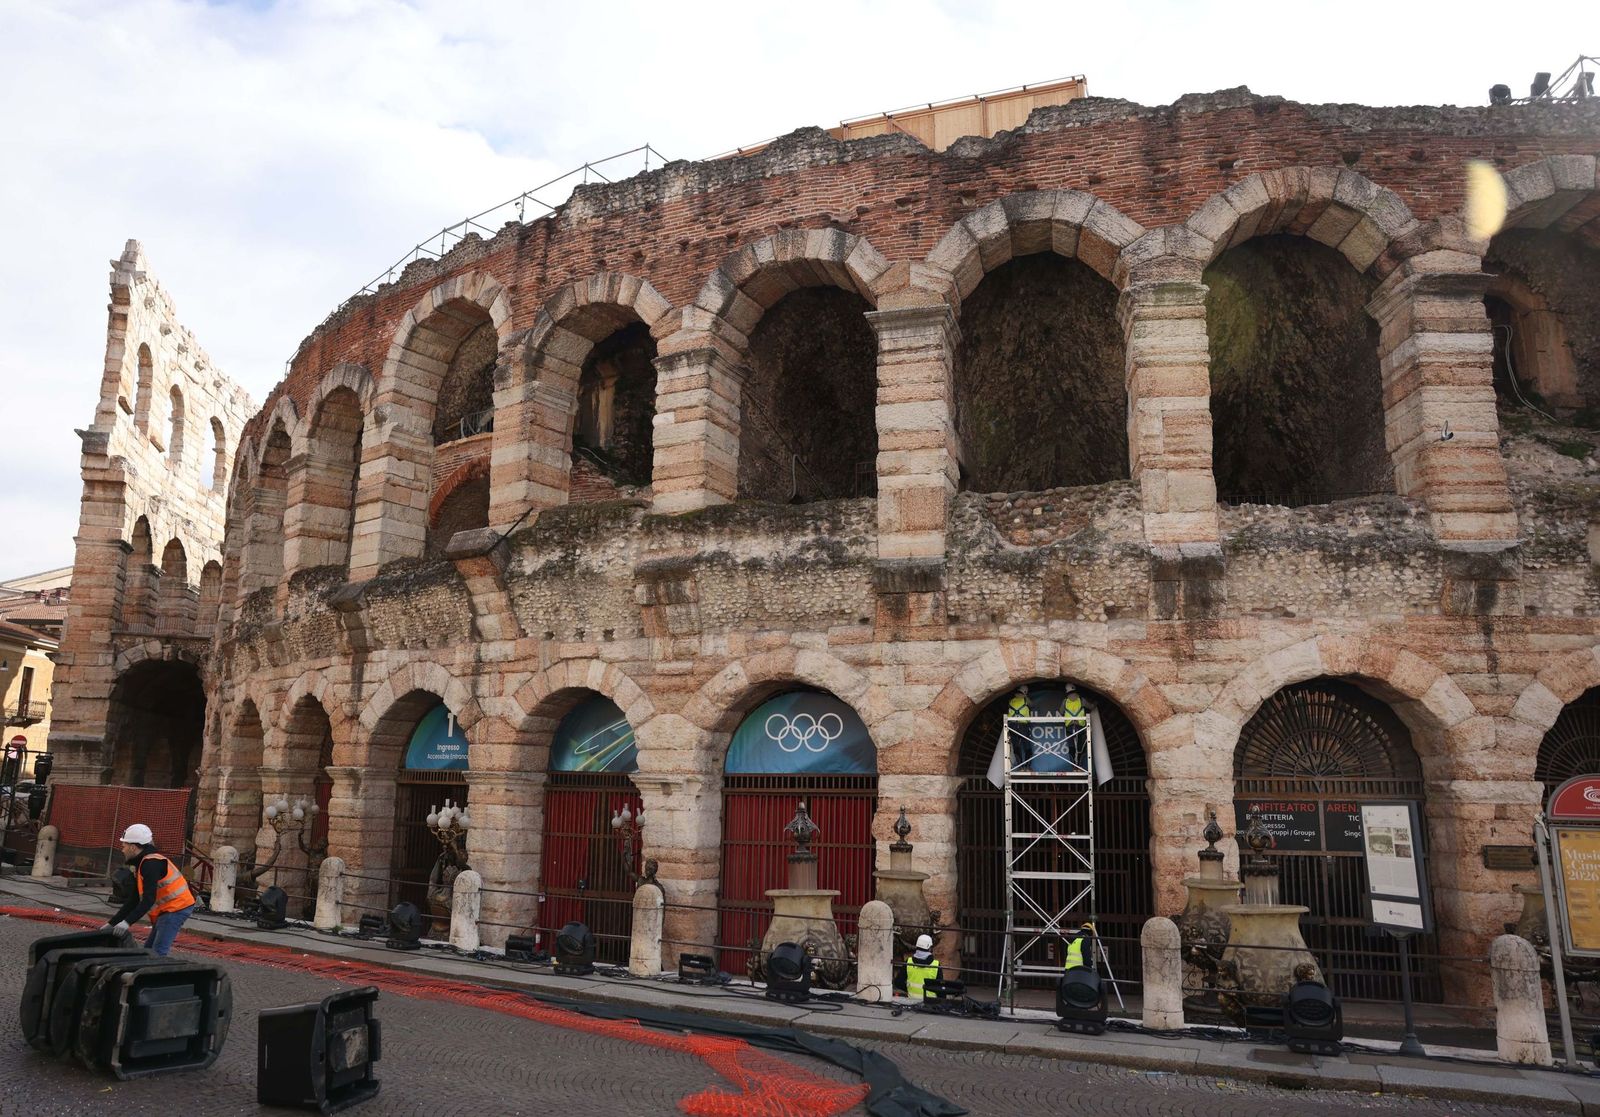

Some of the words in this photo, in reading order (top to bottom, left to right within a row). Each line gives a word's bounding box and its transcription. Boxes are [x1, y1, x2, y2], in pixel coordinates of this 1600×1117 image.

[437, 744, 460, 752] Ingresso
[1034, 741, 1070, 755] 2026
[1326, 802, 1357, 812] AREN
[1268, 829, 1289, 837] Gruppi
[1293, 829, 1316, 838] Groups
[1567, 870, 1599, 881] 2026
